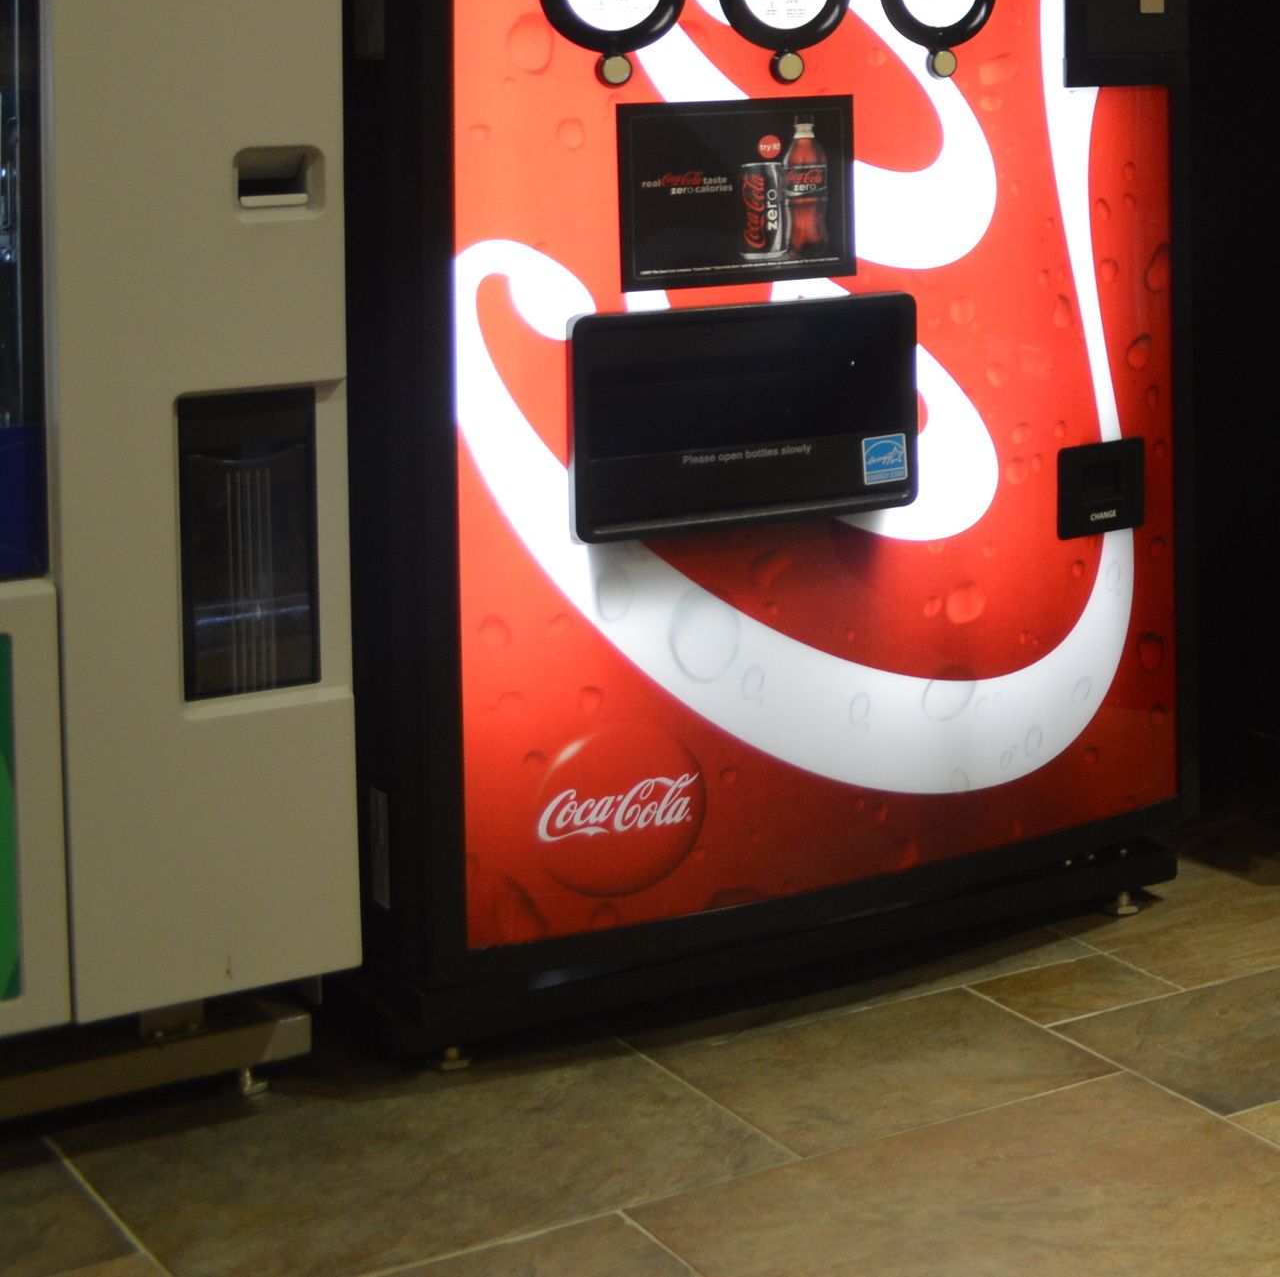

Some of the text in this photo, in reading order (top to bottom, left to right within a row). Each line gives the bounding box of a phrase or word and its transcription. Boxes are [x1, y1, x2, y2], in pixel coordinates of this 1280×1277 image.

[760, 143, 771, 153] try
[641, 178, 661, 189] real
[703, 175, 728, 186] taste
[670, 182, 734, 196] zero calories
[793, 181, 818, 192] zero
[766, 188, 779, 232] zero
[682, 442, 813, 466] Please open bottles slowly
[1089, 509, 1118, 522] CHANGE
[537, 772, 701, 843] Coca-Cola
